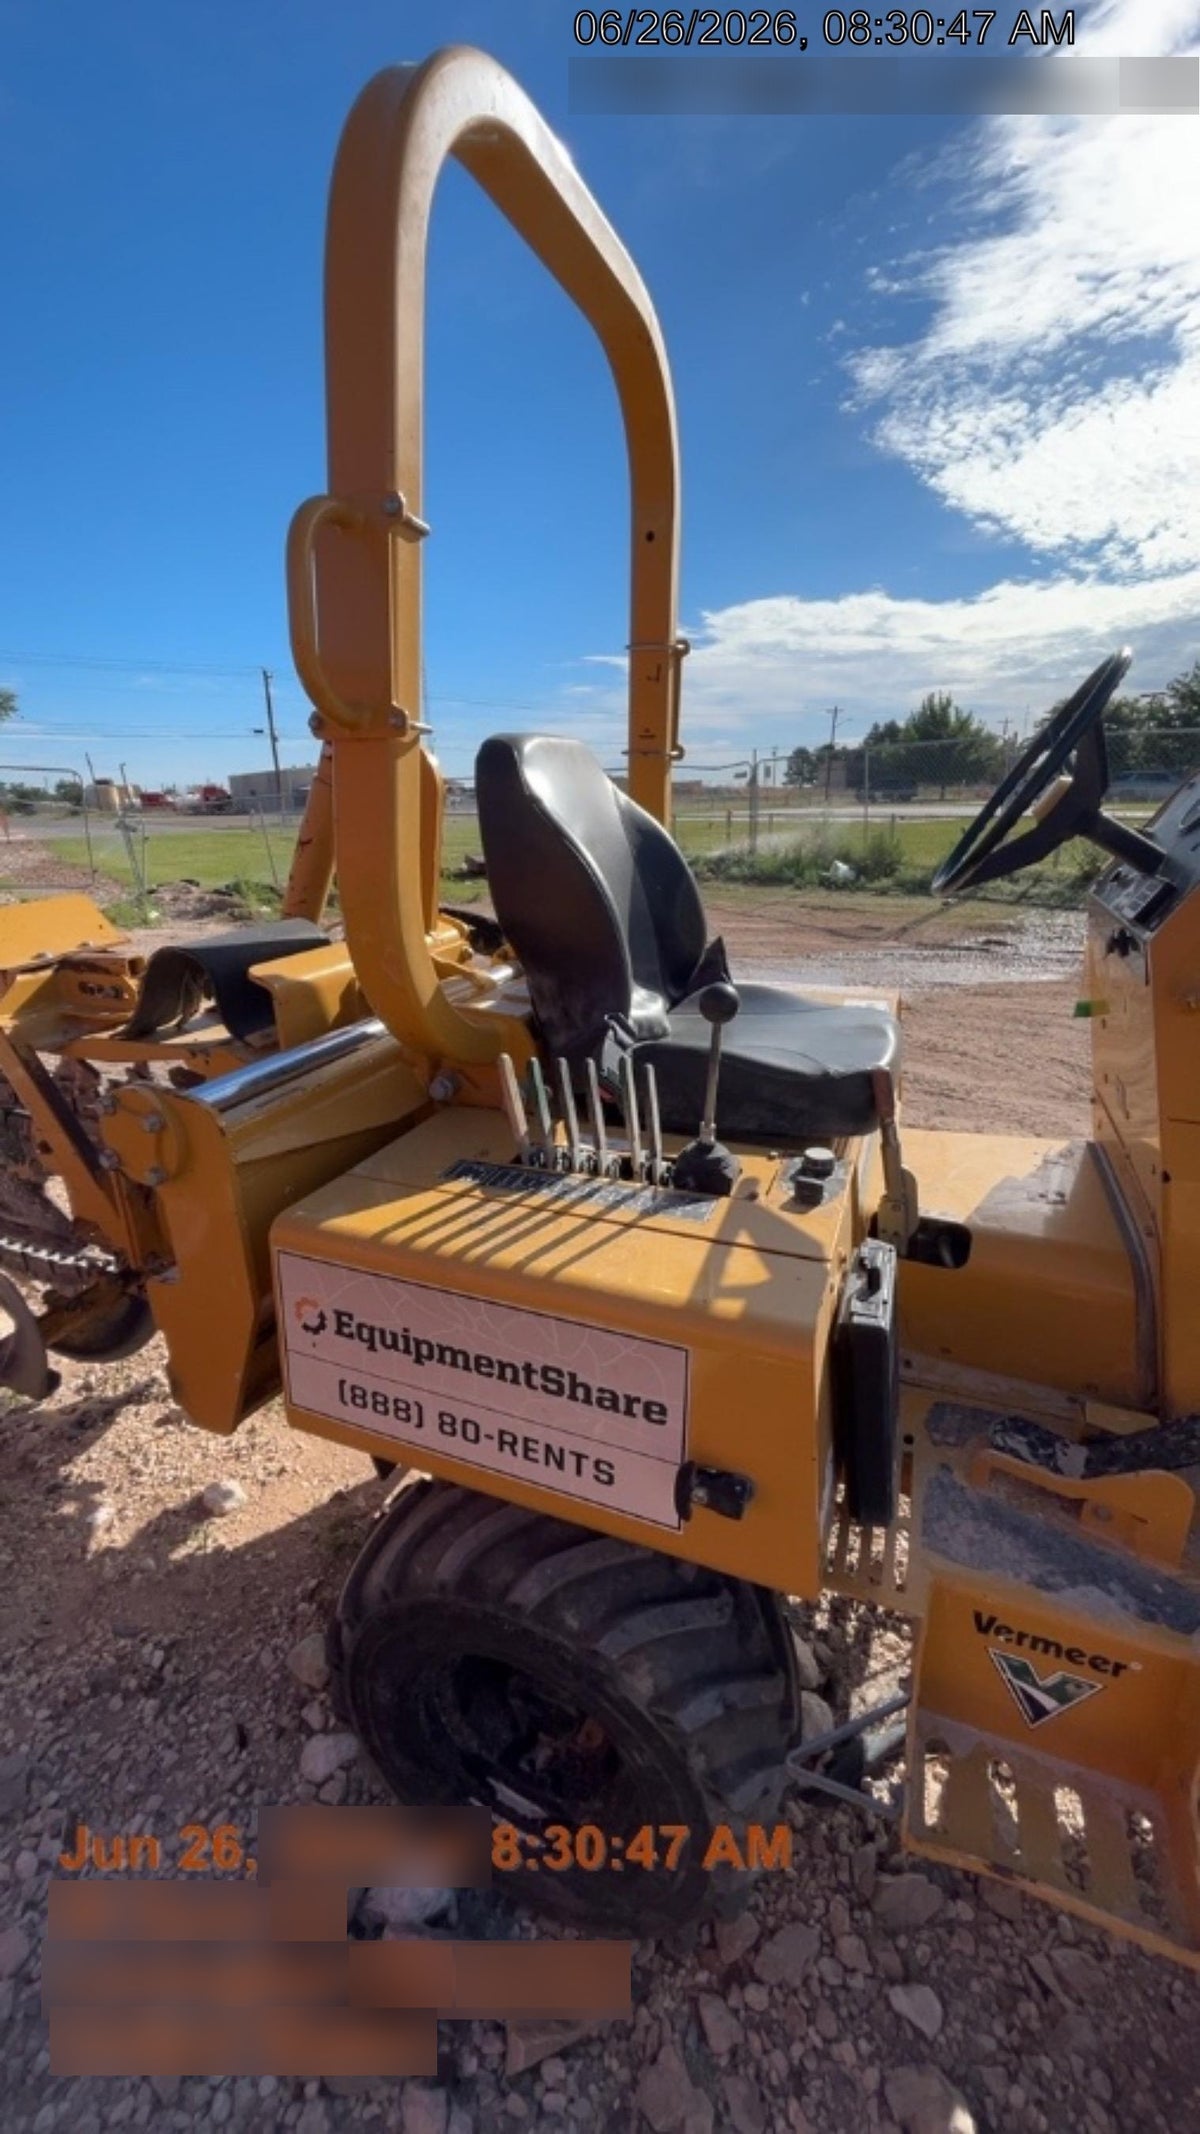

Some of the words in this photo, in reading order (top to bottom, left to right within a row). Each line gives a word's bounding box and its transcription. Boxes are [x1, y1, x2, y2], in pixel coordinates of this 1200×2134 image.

[332, 1308, 669, 1427] EquipmentShare
[338, 1379, 424, 1429] (888)
[437, 1411, 617, 1487] 80-RENTS
[972, 1609, 1128, 1678] Vermeer
